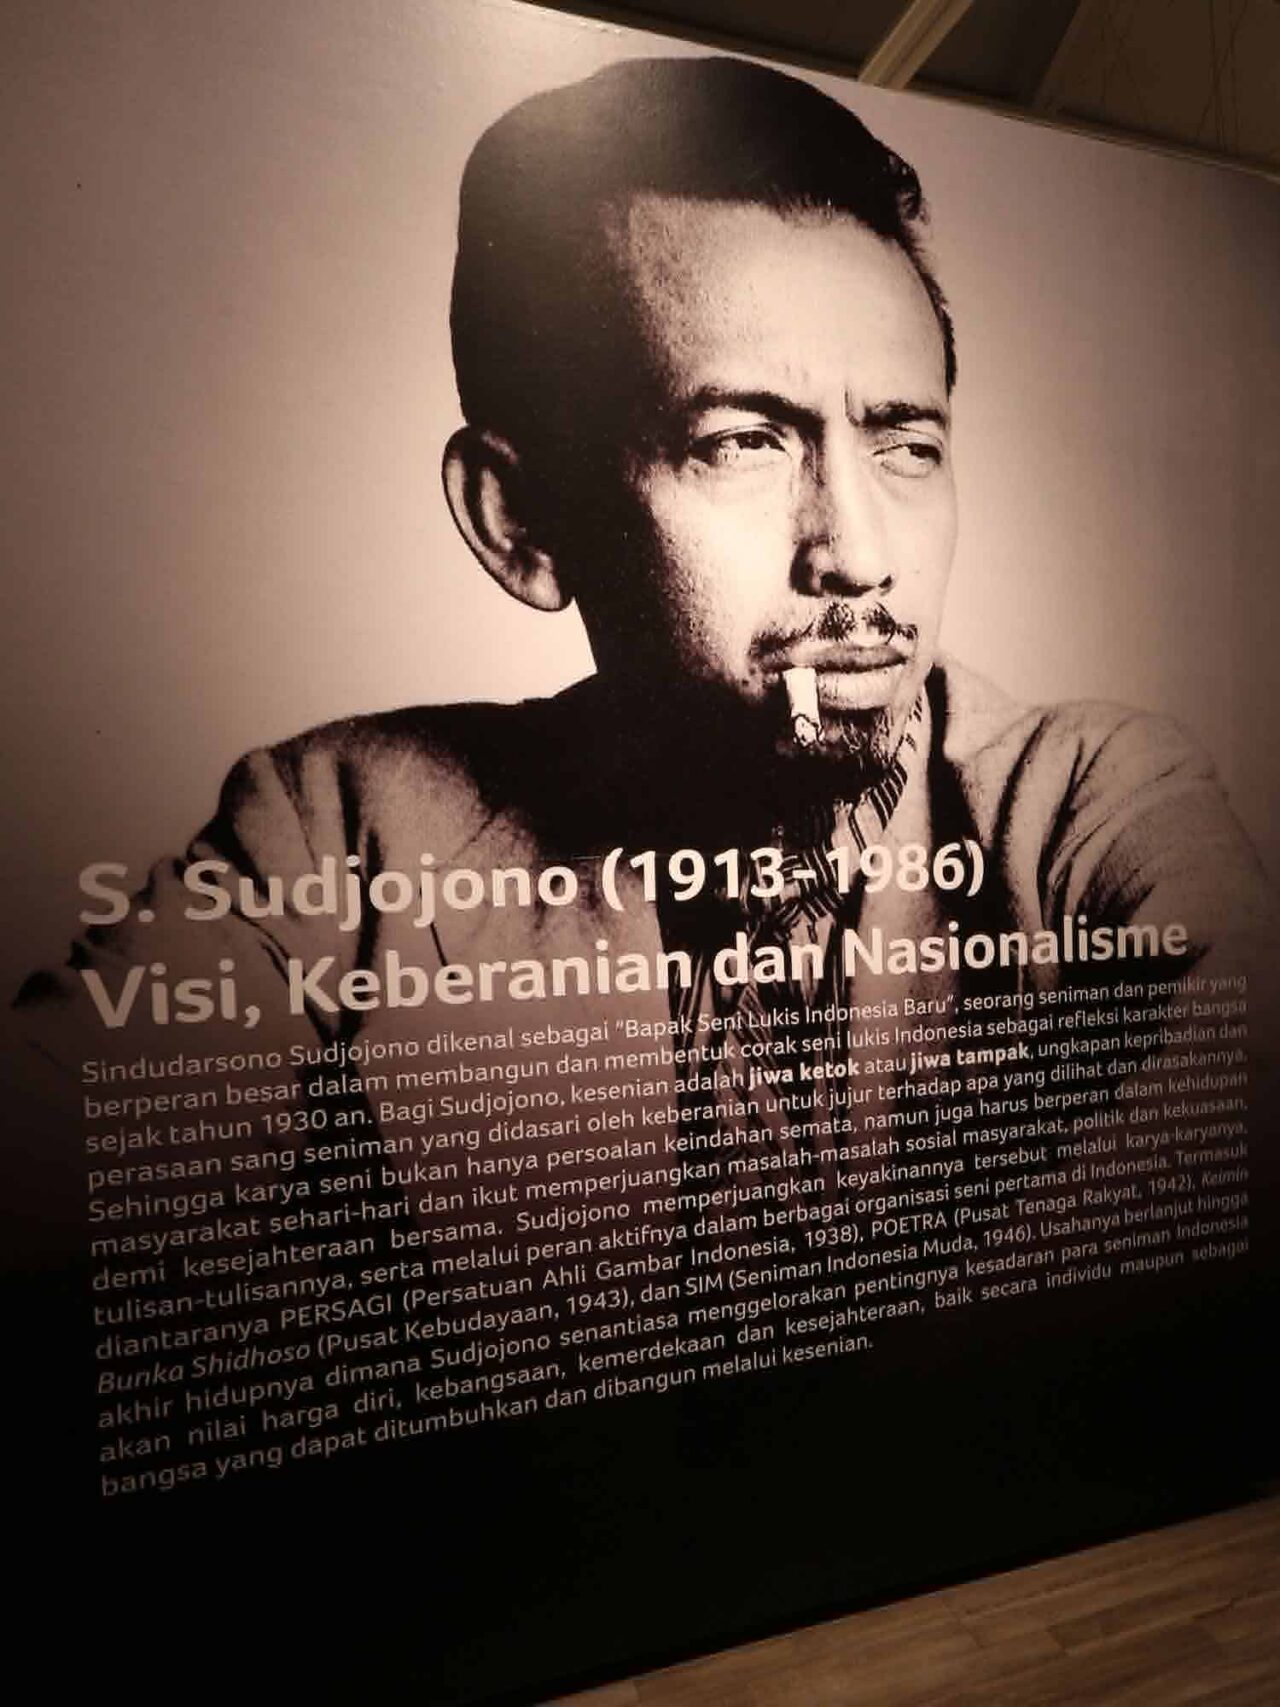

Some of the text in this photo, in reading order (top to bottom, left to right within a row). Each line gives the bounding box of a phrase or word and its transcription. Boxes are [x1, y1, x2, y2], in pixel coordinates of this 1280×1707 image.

[78, 861, 154, 924] S.
[182, 852, 578, 930] Sudjojono
[80, 914, 1189, 1029] Visi, Keberanian dan Nasionalisme
[81, 1049, 282, 1083] Sindudarsono
[289, 1037, 421, 1067] Sudjojono
[426, 1026, 513, 1054] dikenal
[520, 1018, 608, 1047] sebagai
[697, 1008, 743, 1031] Seni
[744, 1005, 798, 1028] Lukis
[805, 997, 901, 1023] Indonesia
[963, 992, 1033, 1010] seorang
[83, 1018, 982, 1119] berperan besar dalam membangun dan membentuk corak seni lukis Indonesia
[85, 1041, 1032, 1155] sejak tahun 1930 an. Bagi Sudjojono, kesenian adalah jiwa ketok atau jiwa tampak,
[87, 1074, 998, 1193] perasaan sang seniman yang didasari oleh keberanian untuk jujur terhadap apa
[89, 1097, 1027, 1221] Sehingga karya seni bukan hanya persoalan keindahan semata, namun juga harus
[91, 1128, 956, 1256] masyarakat sehari-hari dan ikut memperjuangkan masalah-masalah sosial
[92, 1158, 964, 1290] demi kesejahteraan bersama. Sudjojono memperjuangkan keyakinannya
[94, 1176, 989, 1325] tulisan-tulisannya, serta melalui peran aktifnya dalam berbagai organisasi seni
[96, 1201, 1009, 1359] diantaranya PERSAGI (Persatuan Ahli Gambar Indonesia, 1938), POETRA (Pusat
[98, 1234, 977, 1393] Bunka Shidhoso (Pusat Kebudayaan, 1943), dan SIM (Seniman Indonesia Muda,
[100, 1265, 958, 1427] akhir hidupnya dimana Sudjojono senantiasa menggelorakan pentingnya
[102, 1285, 972, 1460] akan nilai harga diri, kebangsaan, kemerdekaan dan kesejahteraan, baik
[103, 1334, 871, 1494] bangsa yang dapat ditumbuhkan dan dibangun melalui kesenian.
